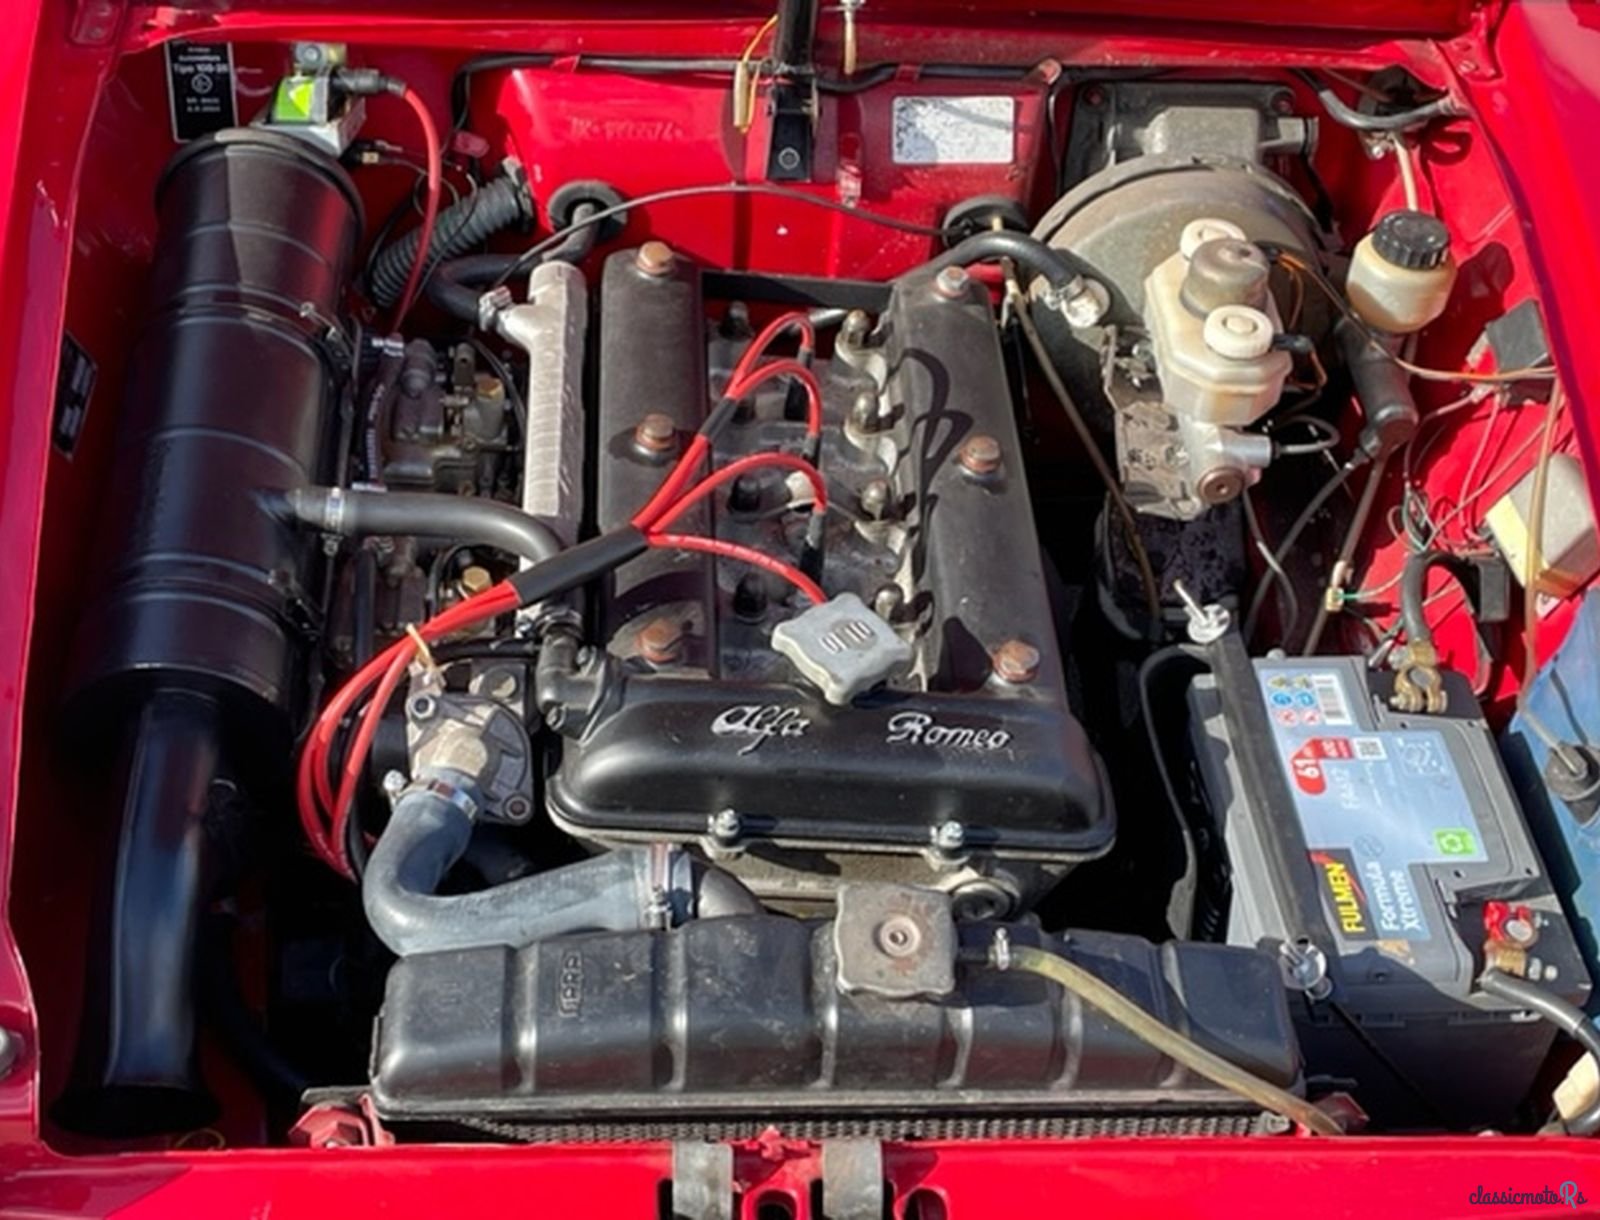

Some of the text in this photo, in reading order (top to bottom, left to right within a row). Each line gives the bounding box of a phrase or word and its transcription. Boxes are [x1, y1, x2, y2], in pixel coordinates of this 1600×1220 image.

[710, 705, 1010, 756] Alfa Romeo
[1294, 758, 1321, 778] 61
[1325, 862, 1366, 933] FULMEN
[1366, 861, 1401, 931] Formula
[1389, 870, 1422, 931] Xtreme
